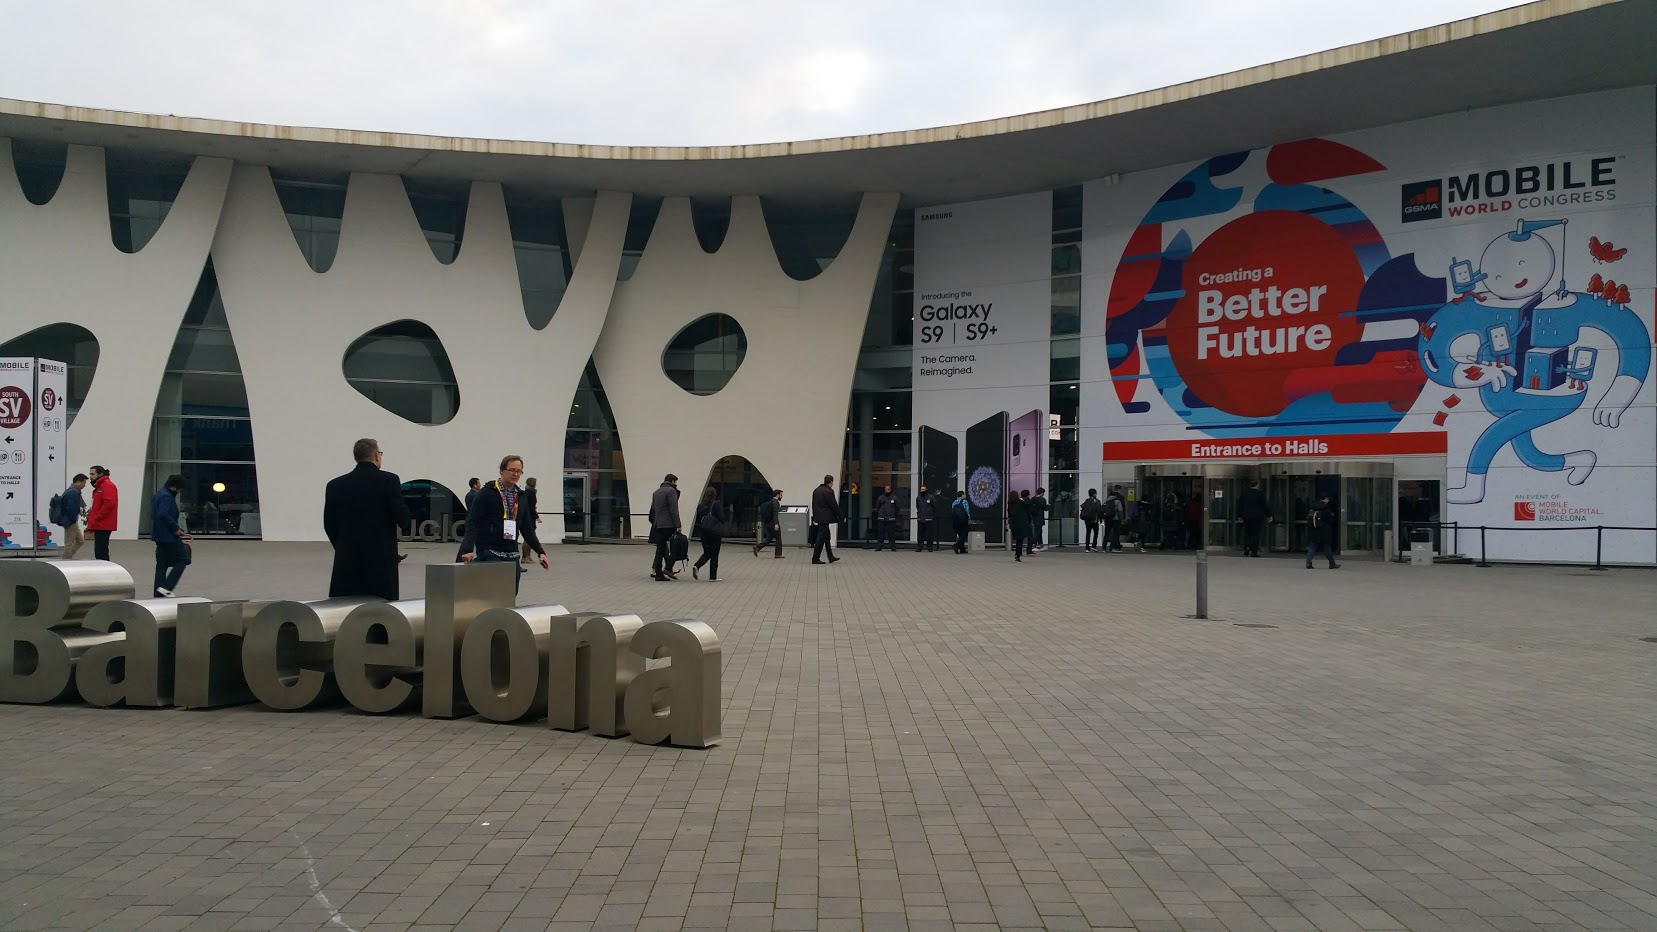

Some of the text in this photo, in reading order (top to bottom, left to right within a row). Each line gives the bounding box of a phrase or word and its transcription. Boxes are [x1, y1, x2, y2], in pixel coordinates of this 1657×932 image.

[1448, 156, 1616, 203] MOBILE
[1404, 203, 1439, 214] GSMA
[1448, 189, 1616, 217] WORLD CONGRESS
[921, 212, 953, 221] SAMSUNG
[1199, 266, 1274, 286] Creating a
[921, 290, 972, 300] Introducing the
[1198, 284, 1327, 324] Better
[920, 302, 993, 322] Galaxy
[921, 322, 998, 343] S9 S9+
[1197, 323, 1332, 360] Future
[46, 364, 65, 373] MOBILE
[921, 354, 977, 364] The Camera.
[920, 366, 974, 377] Reimagined.
[0, 398, 23, 418] SV
[44, 393, 54, 406] SV
[1191, 439, 1329, 457] Entrance to Halls
[0, 560, 721, 748] Barcelona
